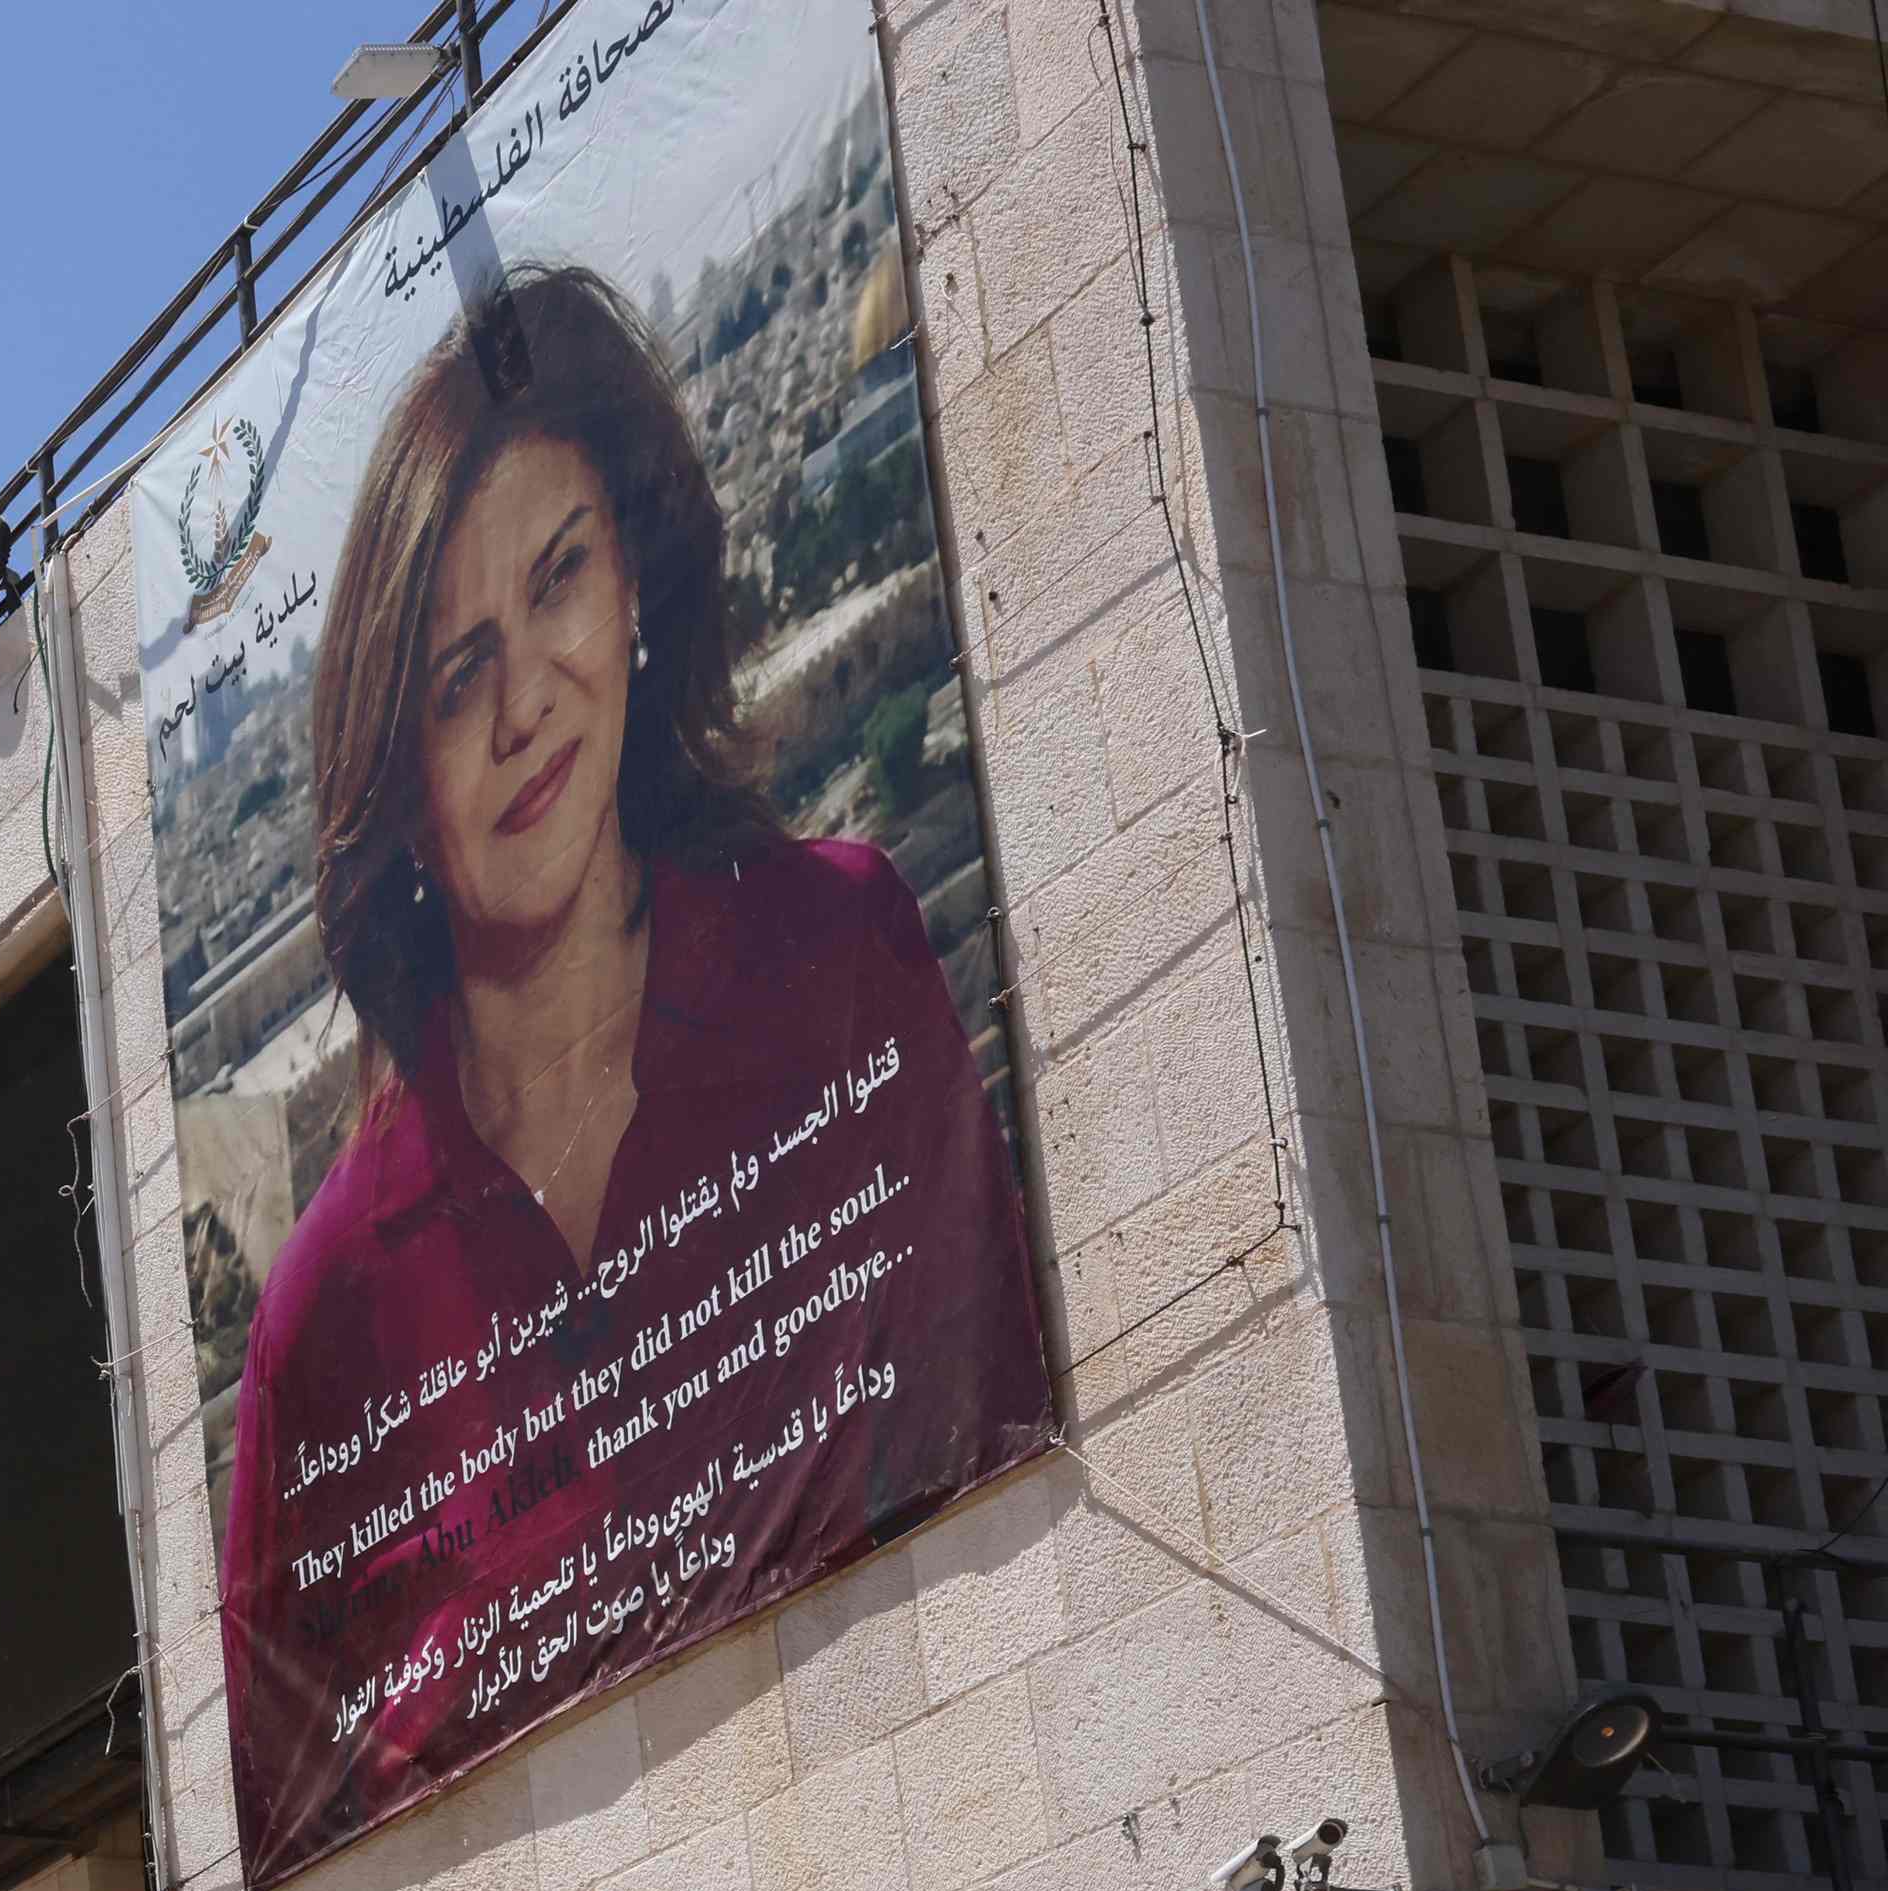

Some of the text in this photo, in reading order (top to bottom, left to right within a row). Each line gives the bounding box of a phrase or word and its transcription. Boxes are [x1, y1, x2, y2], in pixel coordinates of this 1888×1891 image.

[384, 0, 686, 302] صحافة الفلسطينية
[255, 570, 318, 648] بلدية
[204, 640, 247, 694] بيت
[159, 673, 197, 763] لحم
[845, 1036, 901, 1114] قتلوا
[767, 1080, 839, 1163] الجسد
[660, 1175, 722, 1249] يقتلوا
[730, 1151, 760, 1212] ولم
[475, 1311, 502, 1381] أبو
[509, 1280, 569, 1356] شيرين
[291, 1162, 911, 1592] They killed the body but they did not kill the soul...
[418, 1355, 468, 1408] عاقلة
[419, 1519, 476, 1567] Abu
[585, 1397, 660, 1470] thank
[663, 1366, 711, 1431] you
[716, 1318, 768, 1386] and
[774, 1243, 914, 1358] goodbye...
[363, 1388, 412, 1453] شكراً
[330, 1361, 896, 1743] وداعاً يا قدسية الهوى وداعاً يا تلحمية الزنار وكوفية الثوار
[651, 1560, 671, 1608] يا
[674, 1531, 736, 1583] وداعاً
[530, 1609, 578, 1683] الحق
[585, 1584, 644, 1636] صوت
